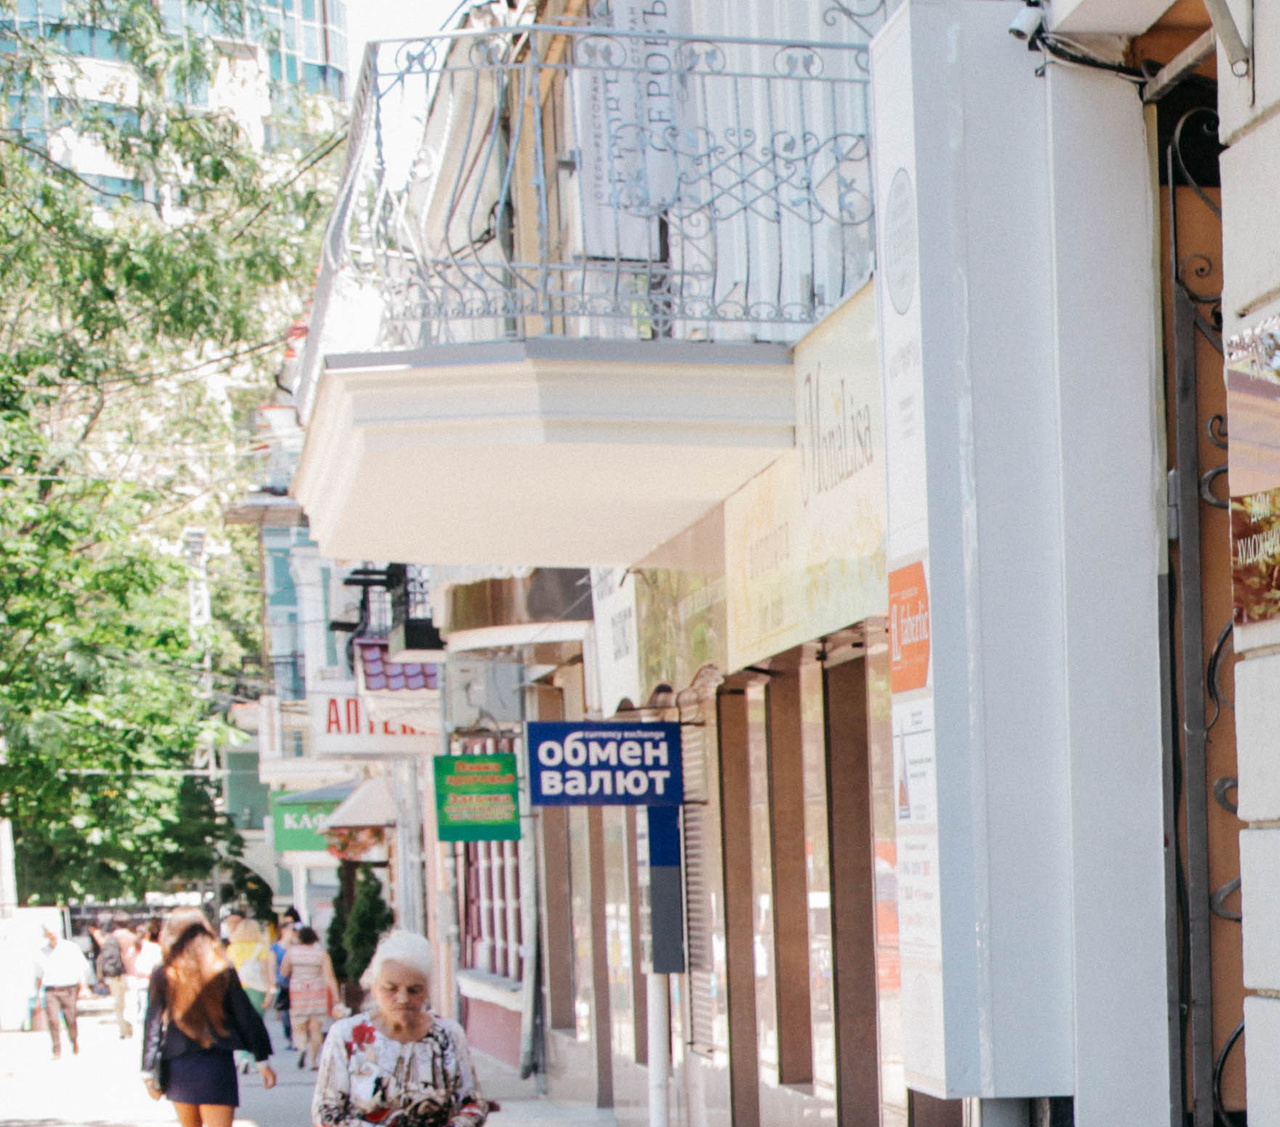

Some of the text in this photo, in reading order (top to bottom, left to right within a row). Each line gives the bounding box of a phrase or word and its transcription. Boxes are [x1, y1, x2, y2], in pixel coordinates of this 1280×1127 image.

[1251, 492, 1270, 523] ДОМ
[537, 730, 669, 767] обмен
[540, 769, 671, 796] валют
